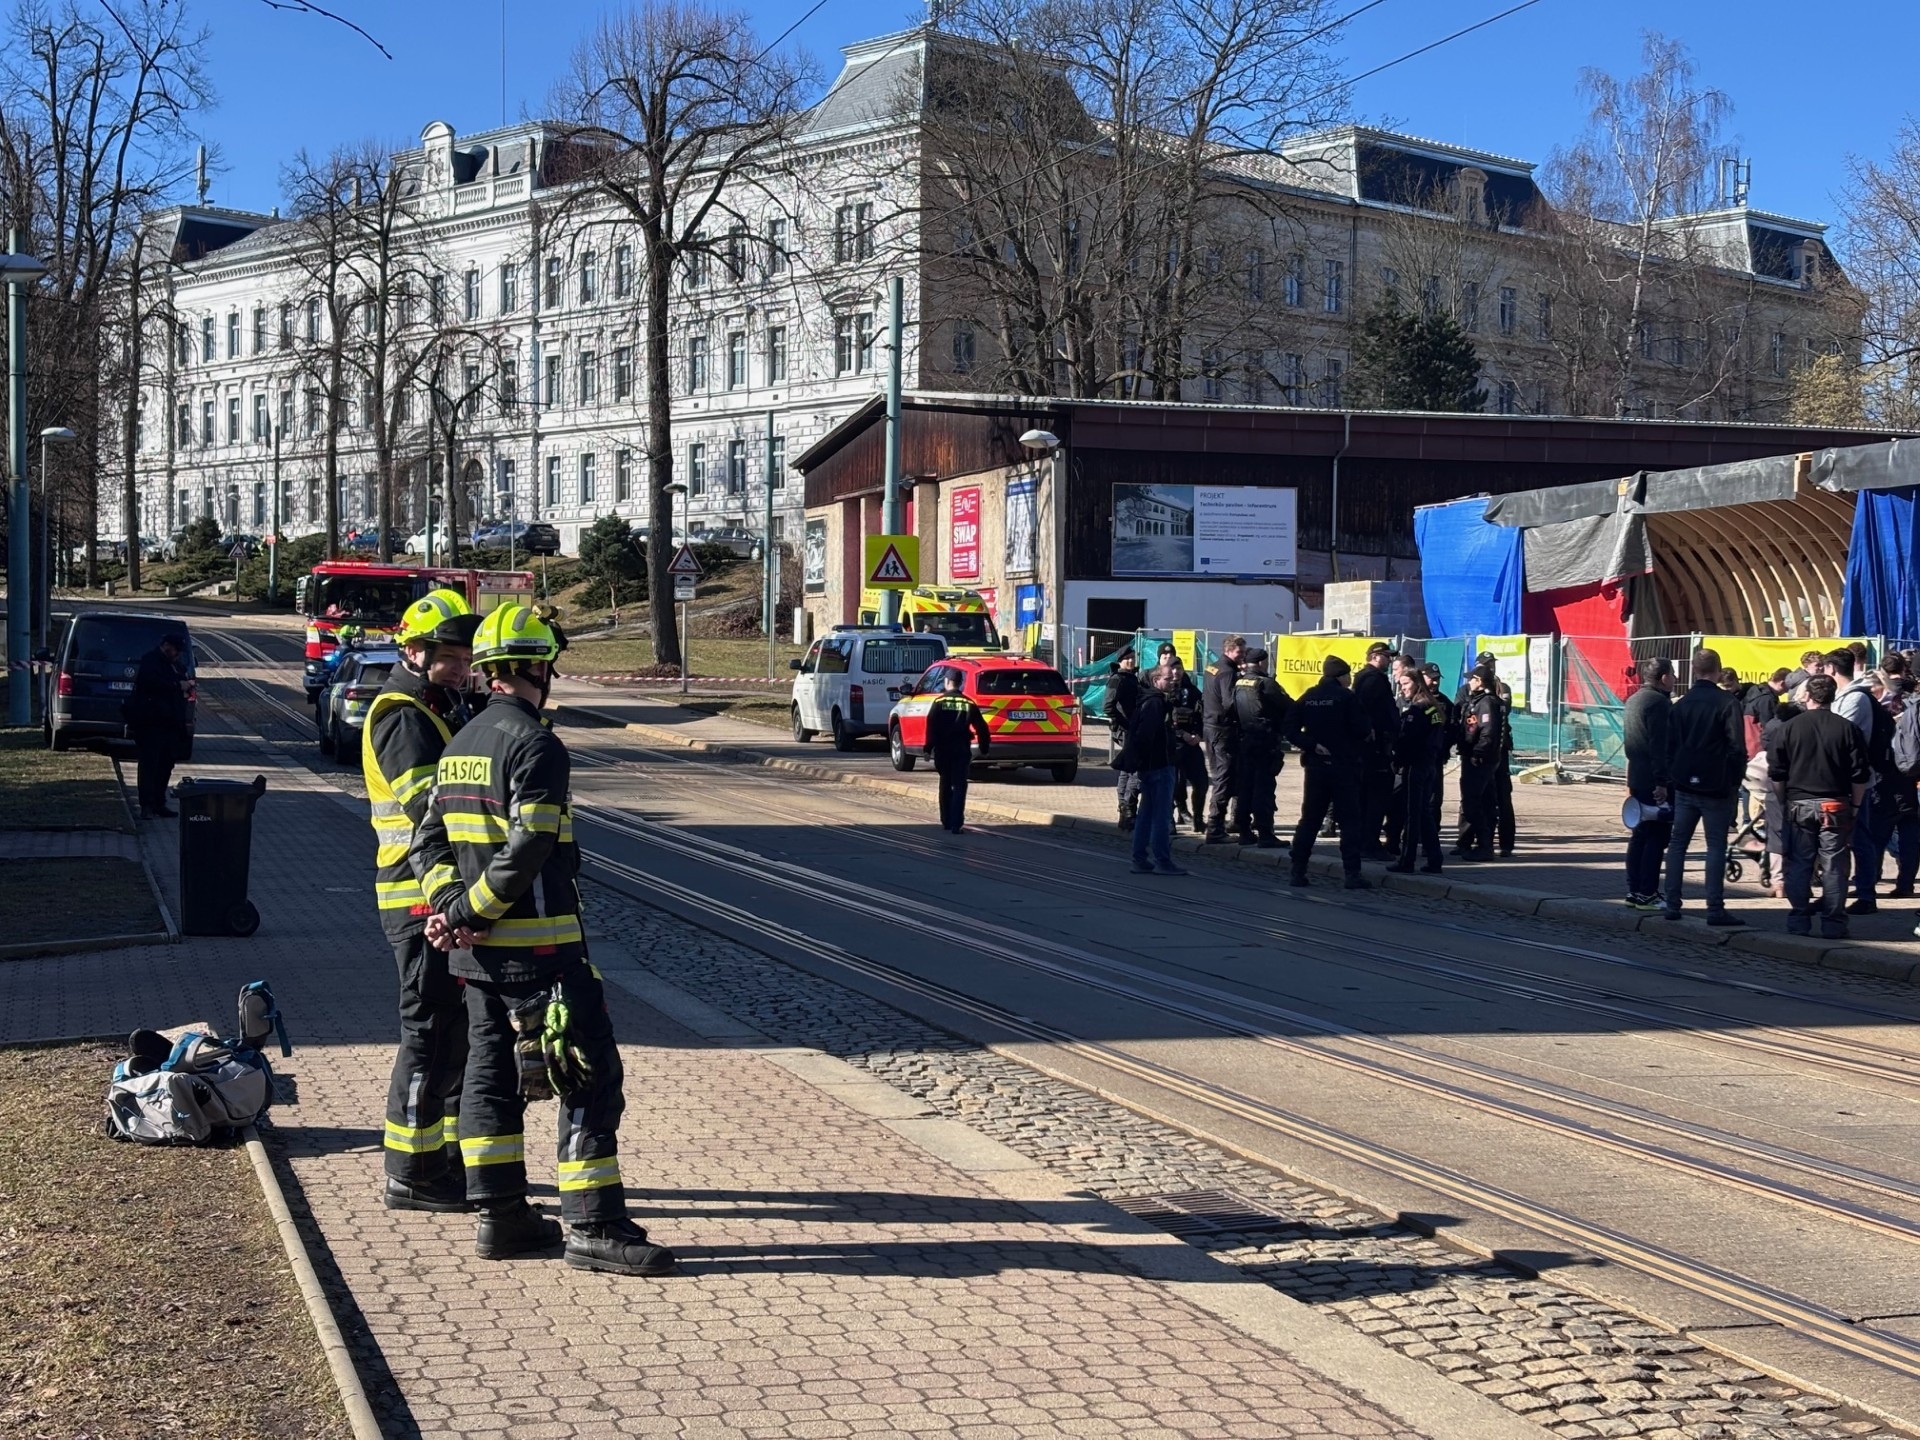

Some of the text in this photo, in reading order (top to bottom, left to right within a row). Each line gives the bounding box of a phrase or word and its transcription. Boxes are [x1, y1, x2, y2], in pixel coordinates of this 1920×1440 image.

[1200, 492, 1225, 500] PROJEKT
[953, 524, 976, 544] SWAP
[1283, 659, 1321, 672] TECHNIC
[439, 758, 488, 781] HASIČI
